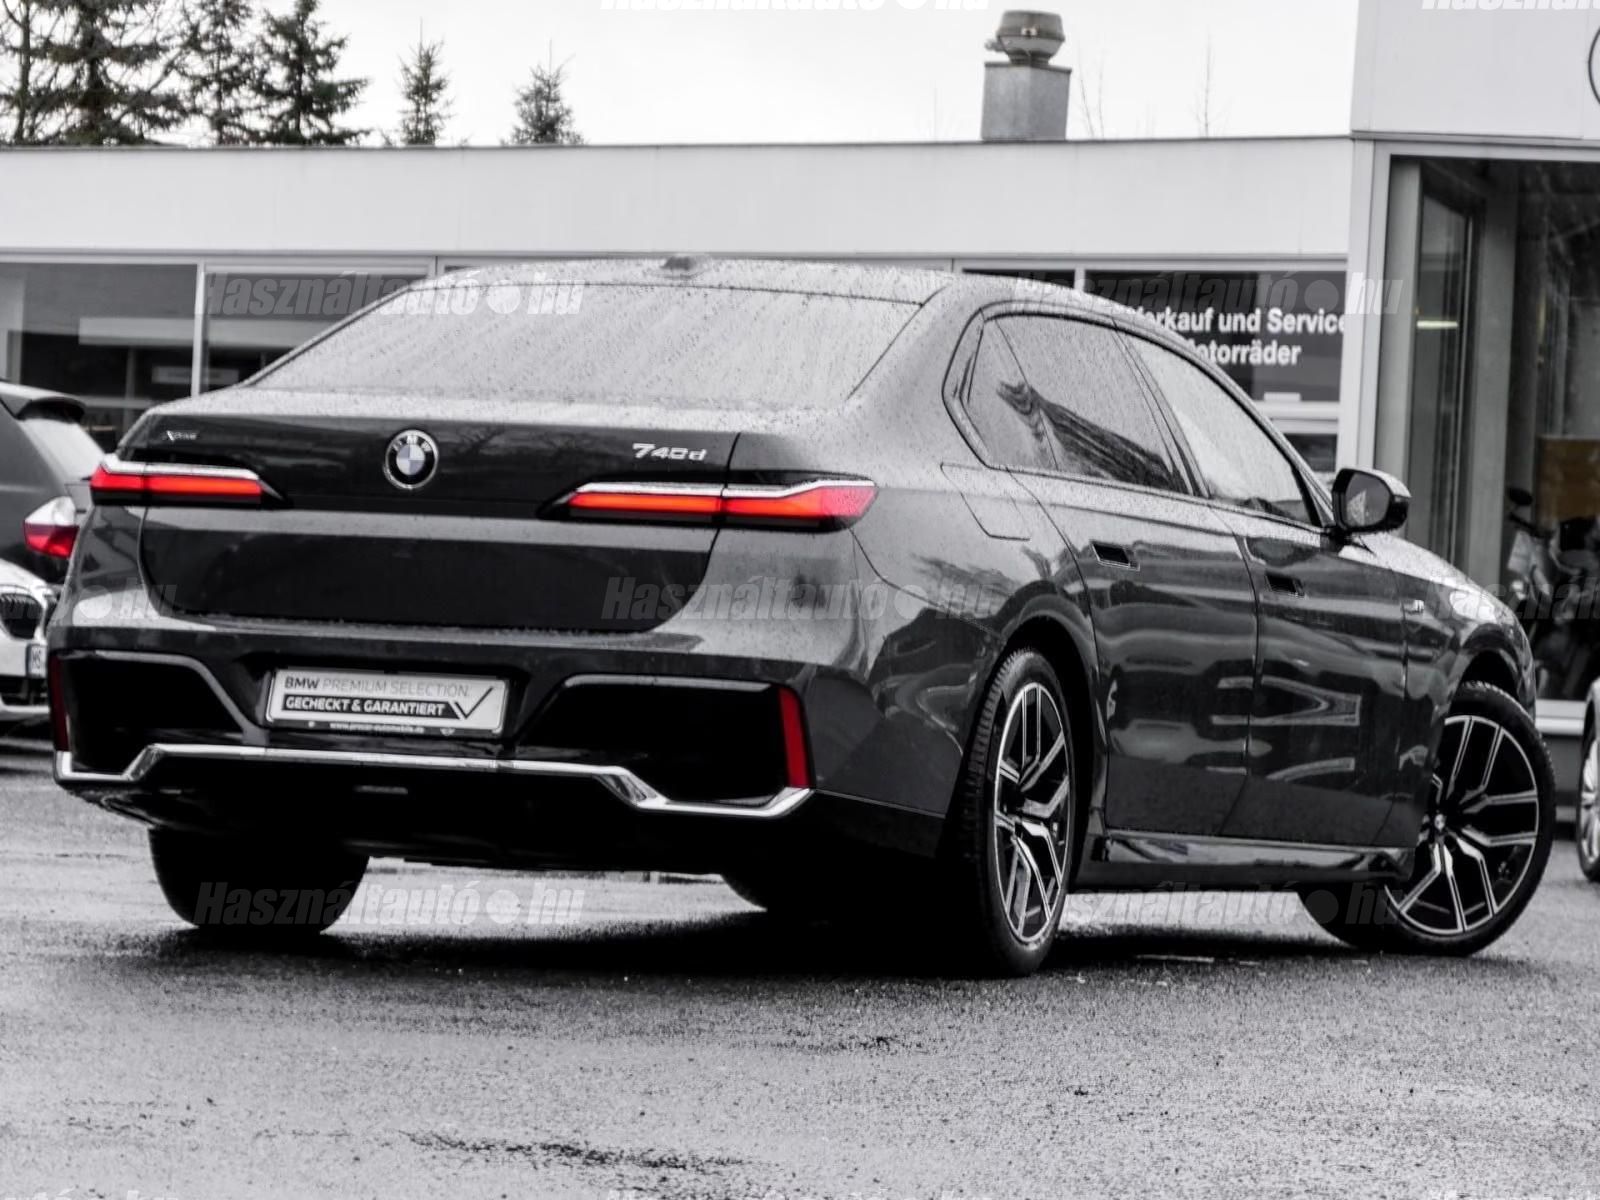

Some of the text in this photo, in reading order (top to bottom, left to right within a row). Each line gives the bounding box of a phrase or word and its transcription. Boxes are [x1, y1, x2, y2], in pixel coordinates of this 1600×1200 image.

[1218, 308, 1260, 333] und
[1186, 338, 1303, 366] otorräder
[632, 442, 707, 461] 740d
[284, 675, 470, 698] BMW PREMIUM SELECTION
[285, 695, 446, 716] GECHECKT & GARANTIERT
